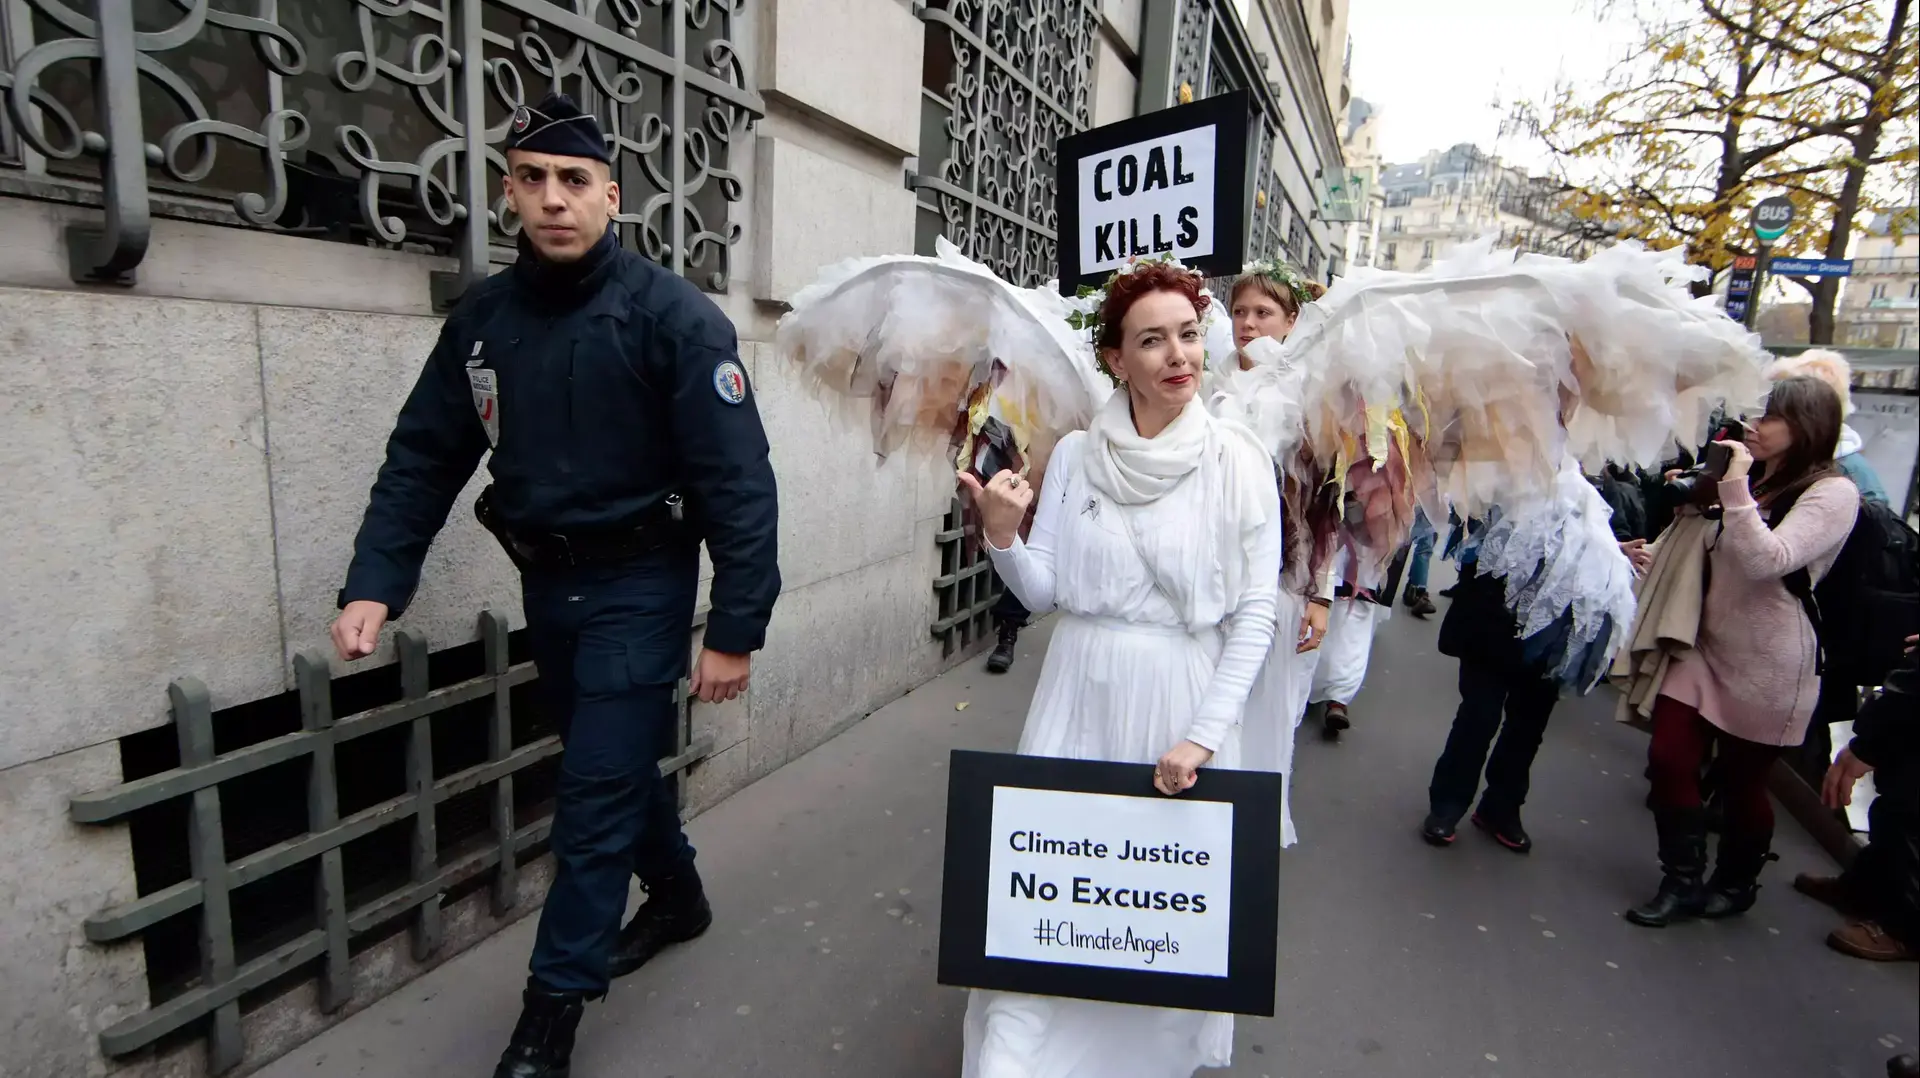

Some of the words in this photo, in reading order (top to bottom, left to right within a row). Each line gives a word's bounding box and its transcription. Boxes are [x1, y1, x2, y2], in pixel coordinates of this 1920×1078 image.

[1094, 145, 1194, 202] COAL
[1095, 206, 1199, 263] KILLS
[1758, 206, 1790, 220] BUS
[1009, 830, 1108, 859] Climate
[1117, 839, 1211, 866] Justice
[1010, 872, 1058, 902] No
[1072, 877, 1207, 913] Excuses
[1033, 918, 1180, 964] #ClimateAngels
